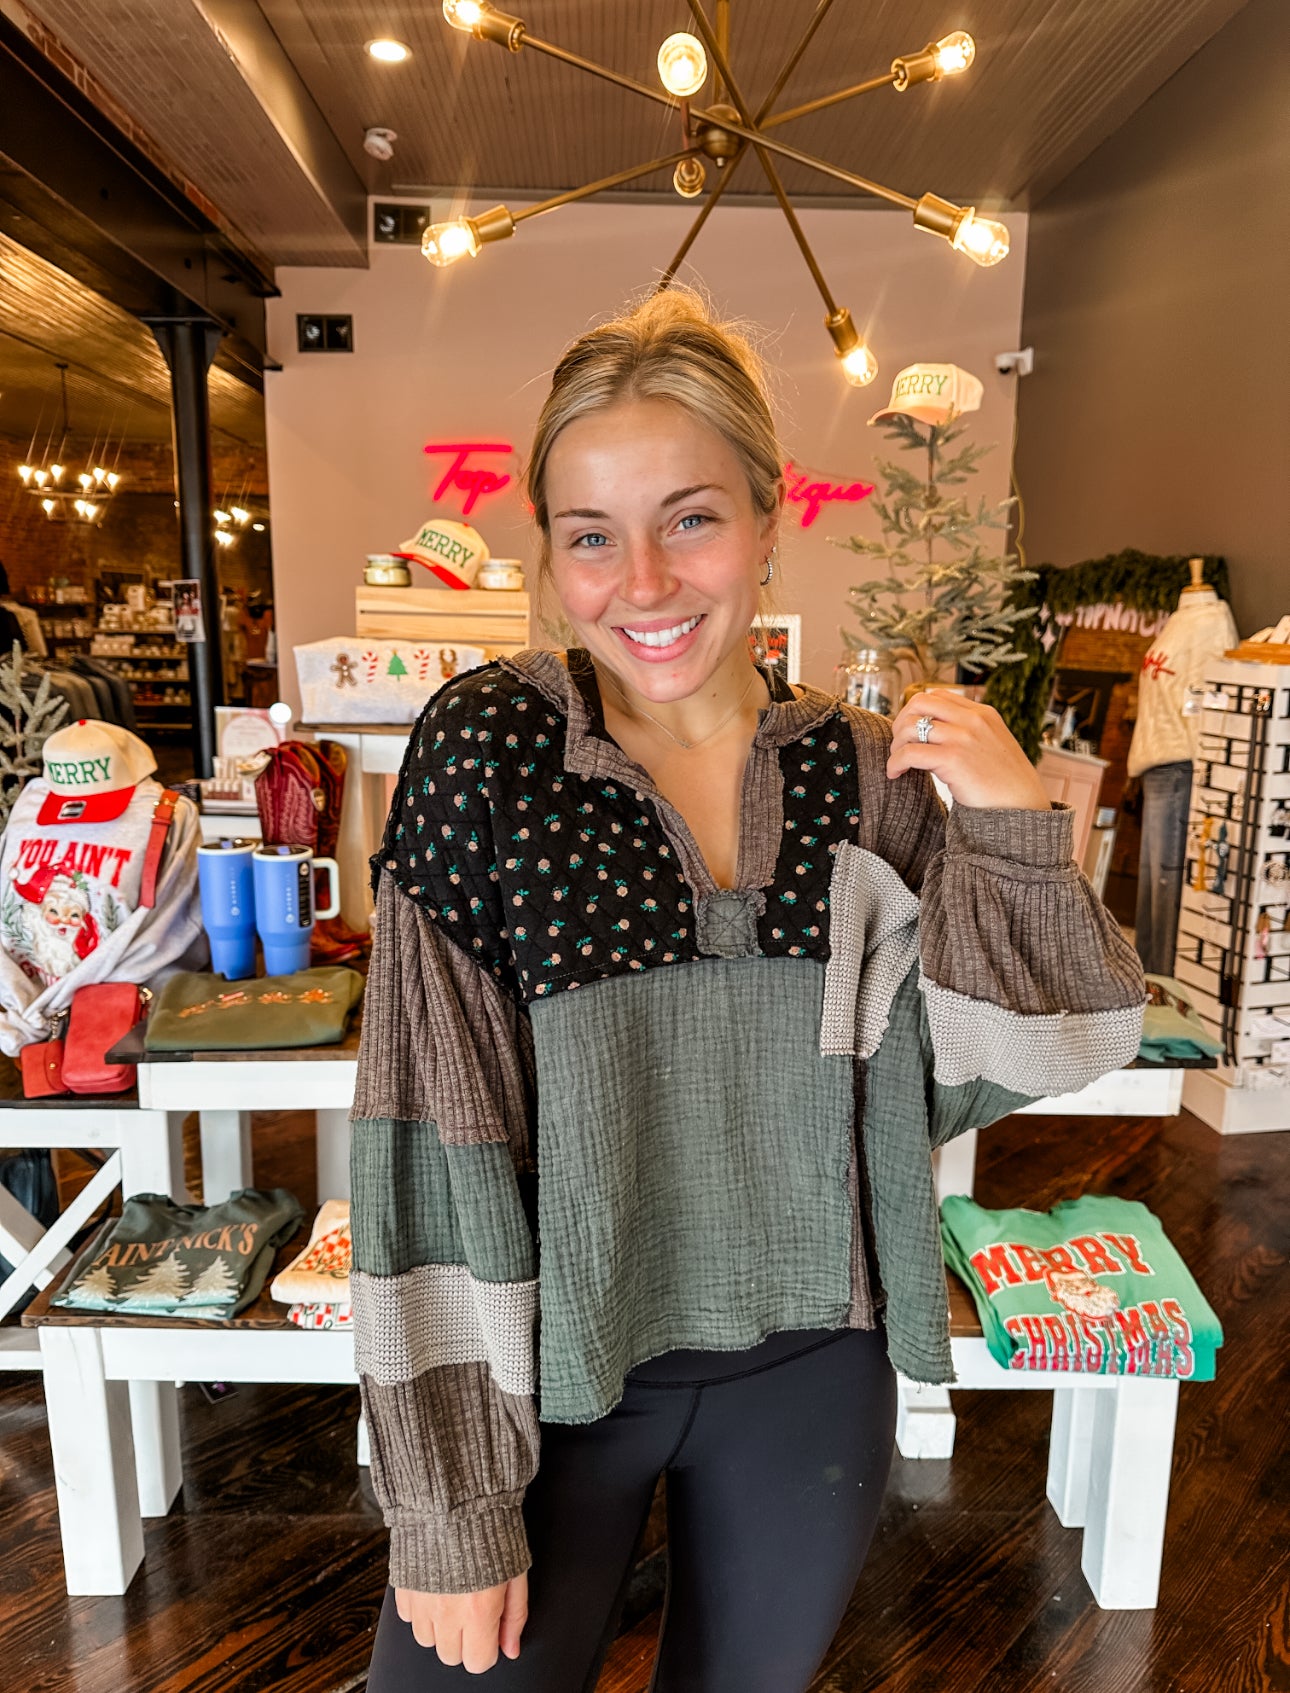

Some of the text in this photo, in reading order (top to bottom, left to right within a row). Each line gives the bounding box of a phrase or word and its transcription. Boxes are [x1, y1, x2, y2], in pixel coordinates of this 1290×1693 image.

[423, 443, 513, 515] Top
[784, 463, 875, 528] ique
[14, 839, 132, 888] YOU AIN'T
[176, 1223, 259, 1256] NICK'S
[968, 1232, 1156, 1299] MERRY
[1003, 1297, 1195, 1368] CHRISTMAS
